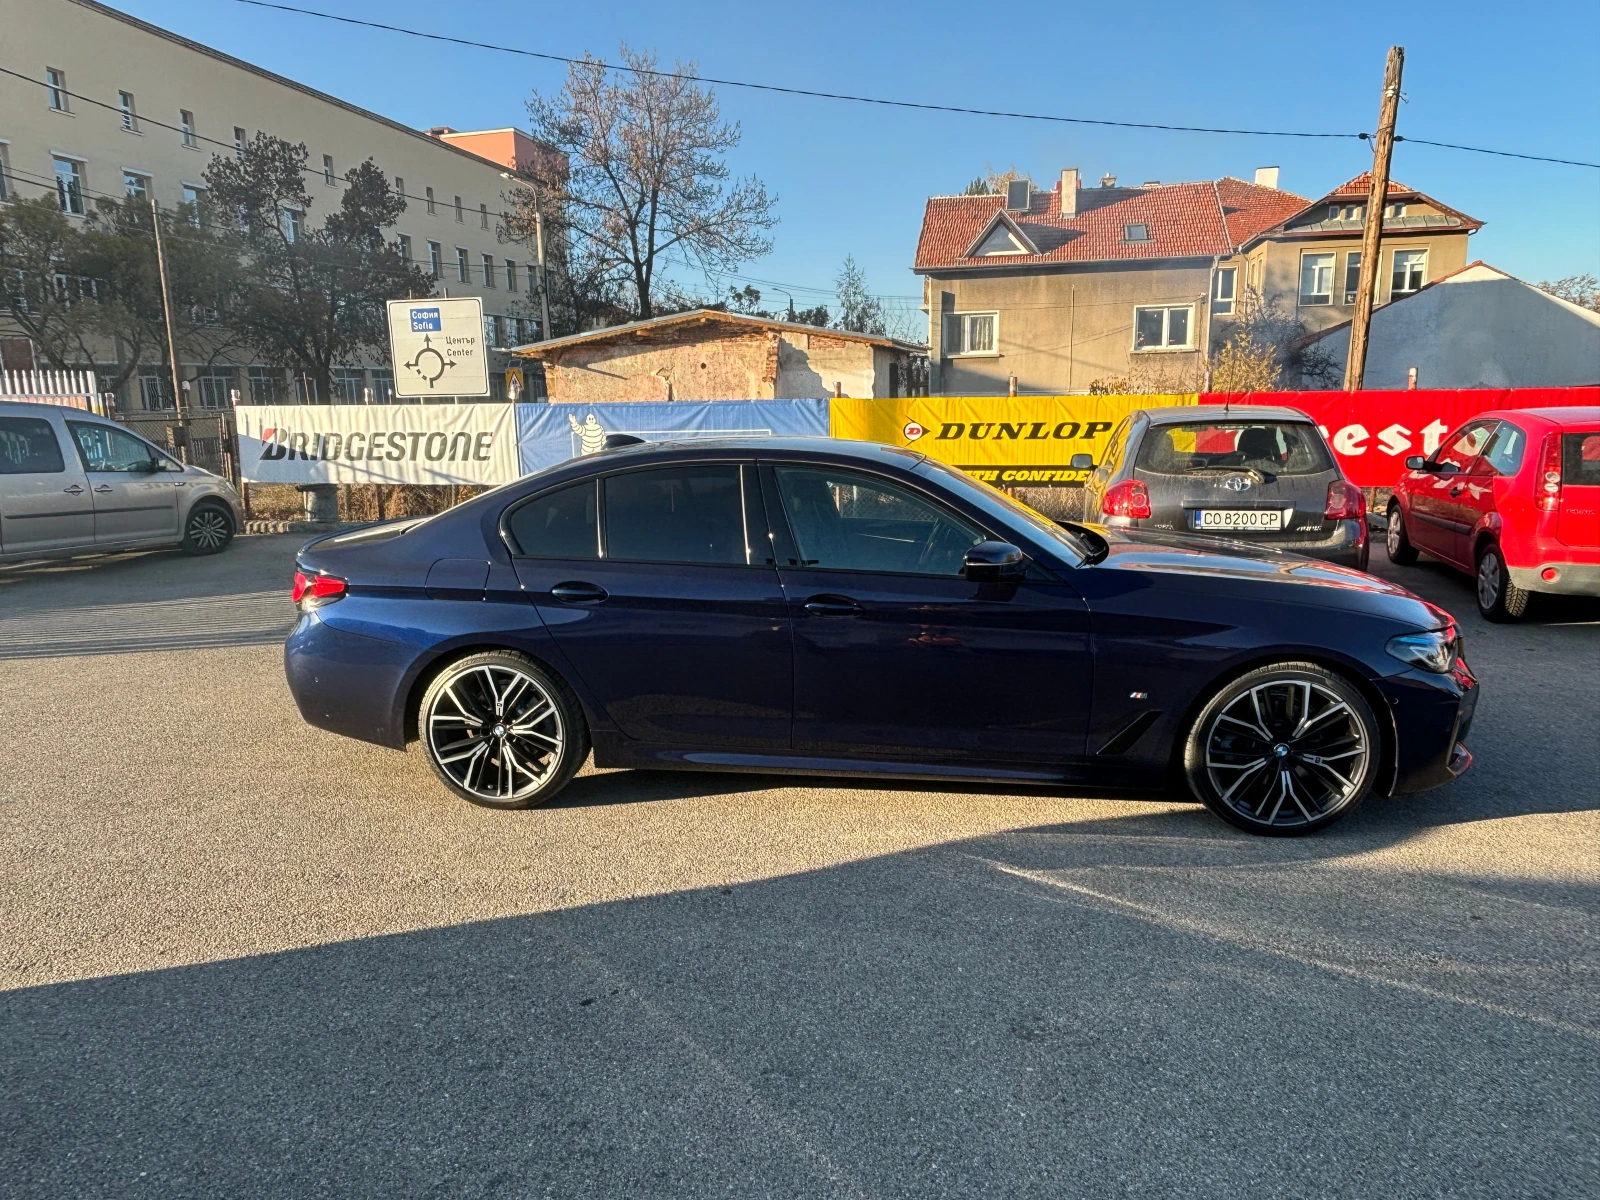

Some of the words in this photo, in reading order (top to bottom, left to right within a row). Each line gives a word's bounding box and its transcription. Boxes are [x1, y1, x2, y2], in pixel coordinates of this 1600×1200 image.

[412, 311, 439, 319] София
[413, 322, 433, 330] Sofia
[445, 336, 475, 345] Център
[446, 348, 473, 357] Center
[935, 422, 1113, 440] DUNLOP
[259, 427, 493, 462] BRIDGESTONE
[1001, 470, 1091, 482] CONFIDE
[1204, 512, 1222, 525] CO
[1224, 512, 1257, 526] 8200
[1260, 513, 1278, 526] CP
